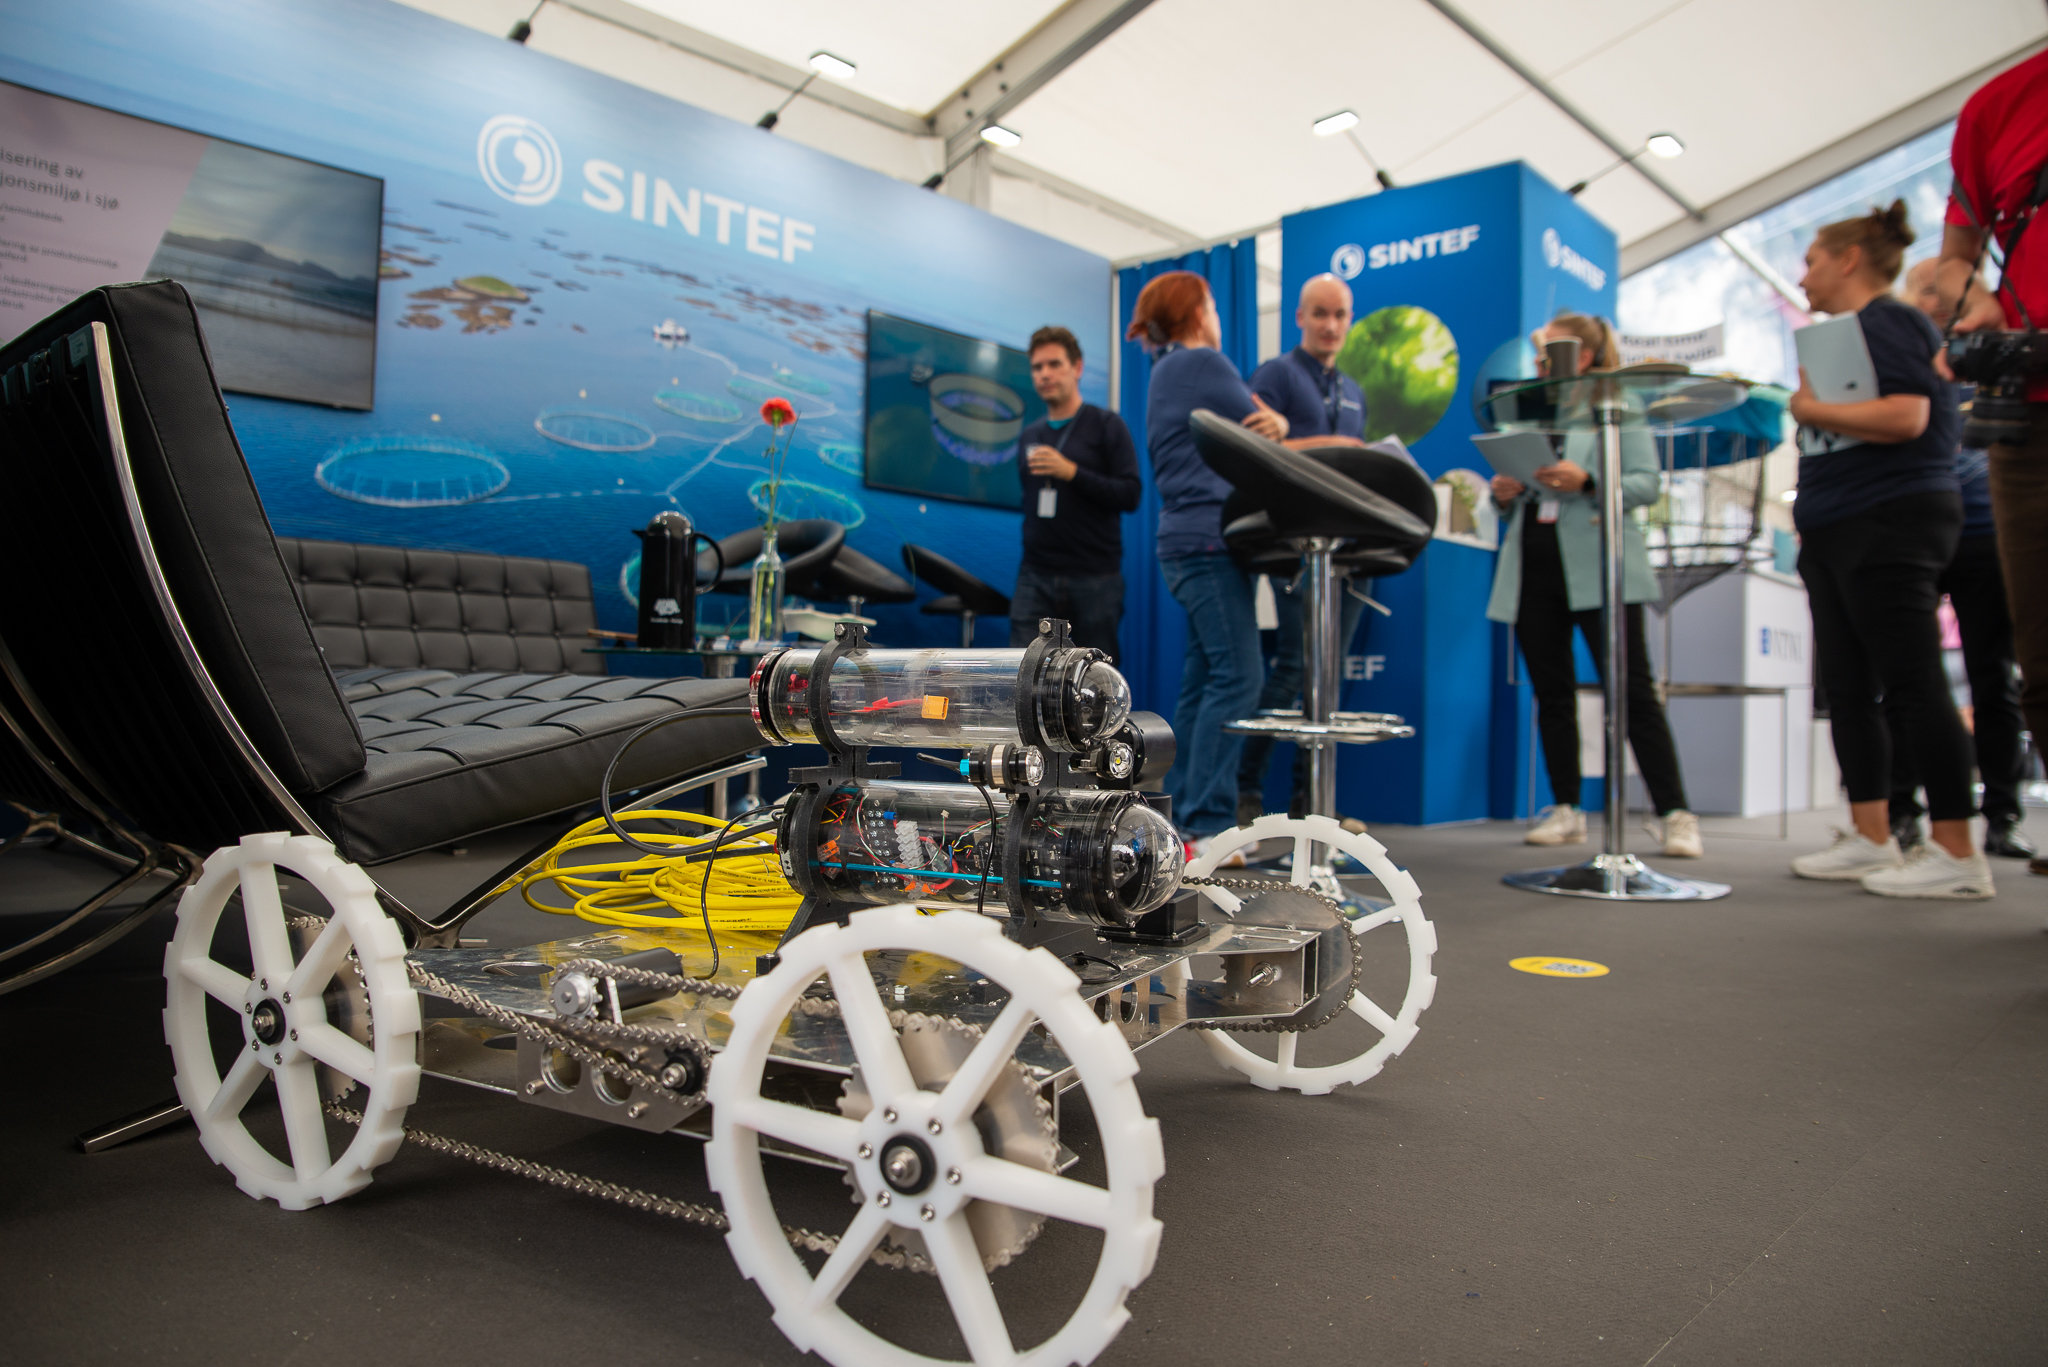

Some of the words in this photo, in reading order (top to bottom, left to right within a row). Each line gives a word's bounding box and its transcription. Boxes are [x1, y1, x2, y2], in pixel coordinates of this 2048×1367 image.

[0, 147, 60, 177] isering
[65, 166, 84, 179] av
[0, 171, 80, 202] jonsmiljø
[94, 193, 119, 210] sjø
[582, 158, 815, 264] SINTEF
[1369, 224, 1480, 270] SINTEF
[1561, 244, 1607, 292] SINTEF
[1344, 654, 1387, 681] EF
